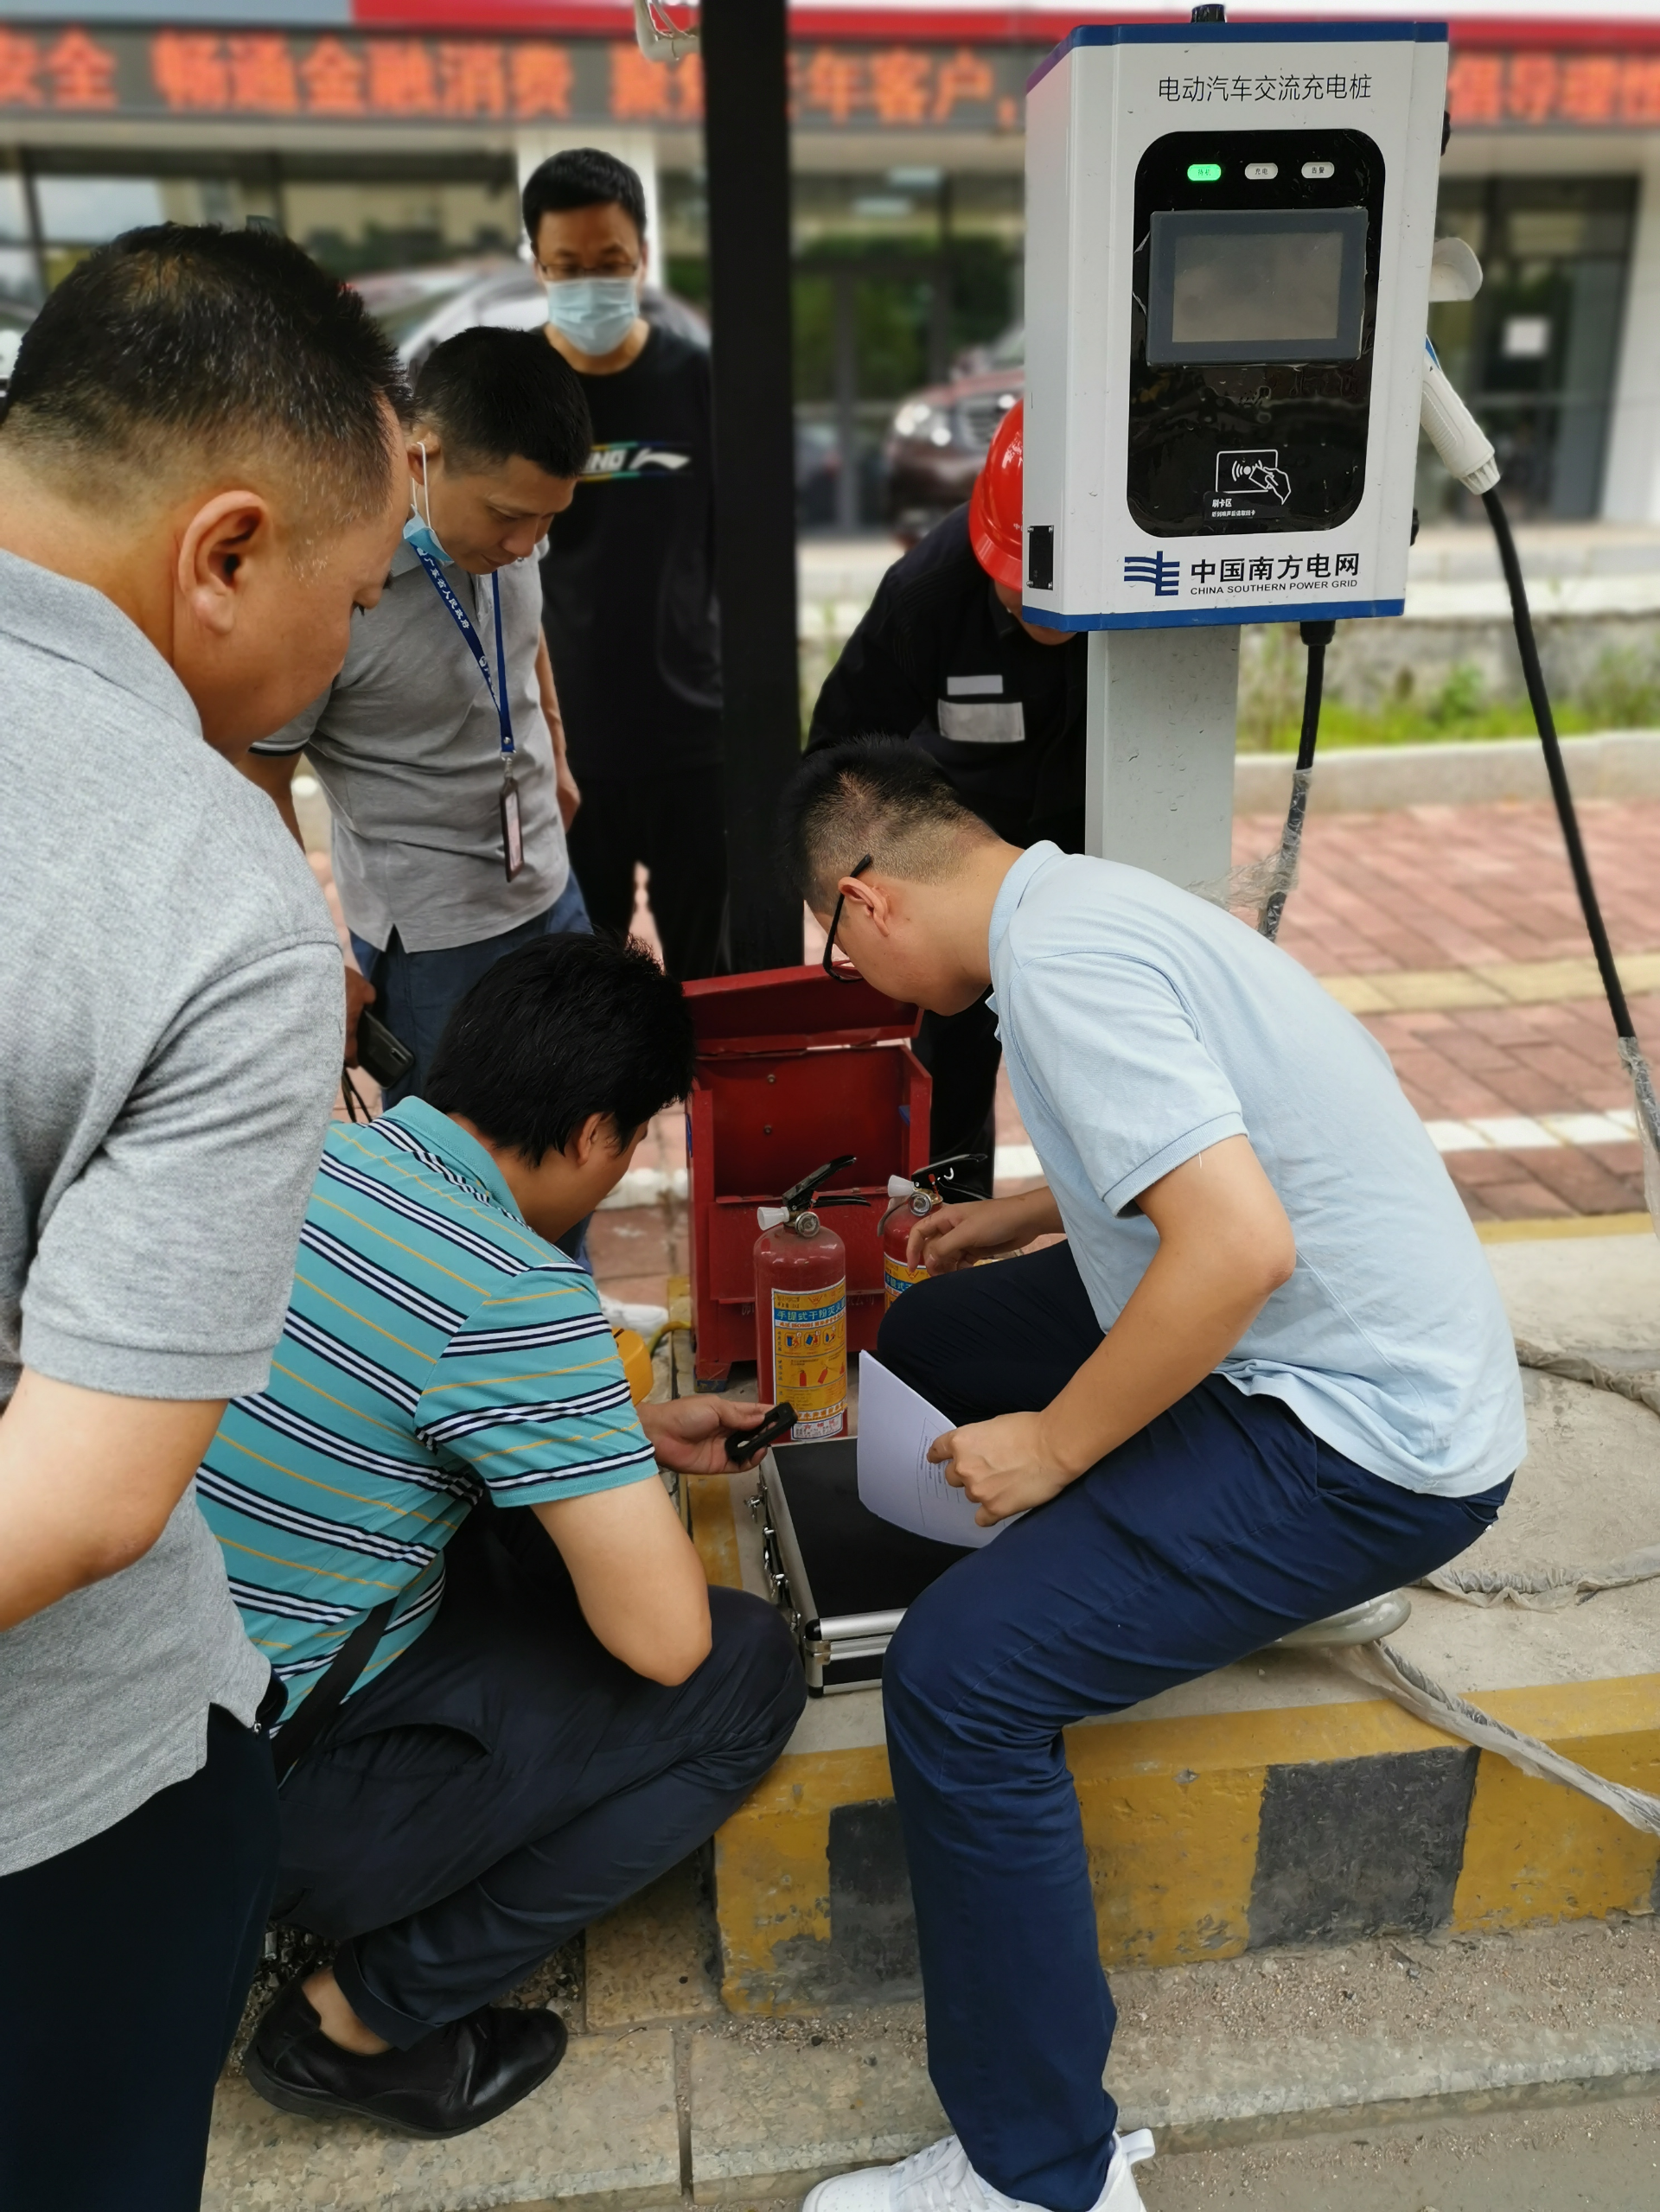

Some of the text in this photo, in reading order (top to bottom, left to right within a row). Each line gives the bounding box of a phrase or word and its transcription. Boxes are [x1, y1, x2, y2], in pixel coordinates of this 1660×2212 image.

[1159, 73, 1372, 102] 电动汽车交流充电桩
[1312, 166, 1325, 175] 告警
[1212, 499, 1232, 507] 刷卡区
[1191, 553, 1360, 583] 中国南方电网
[1191, 579, 1358, 596] CHINA SOUTHERN POWER GRID
